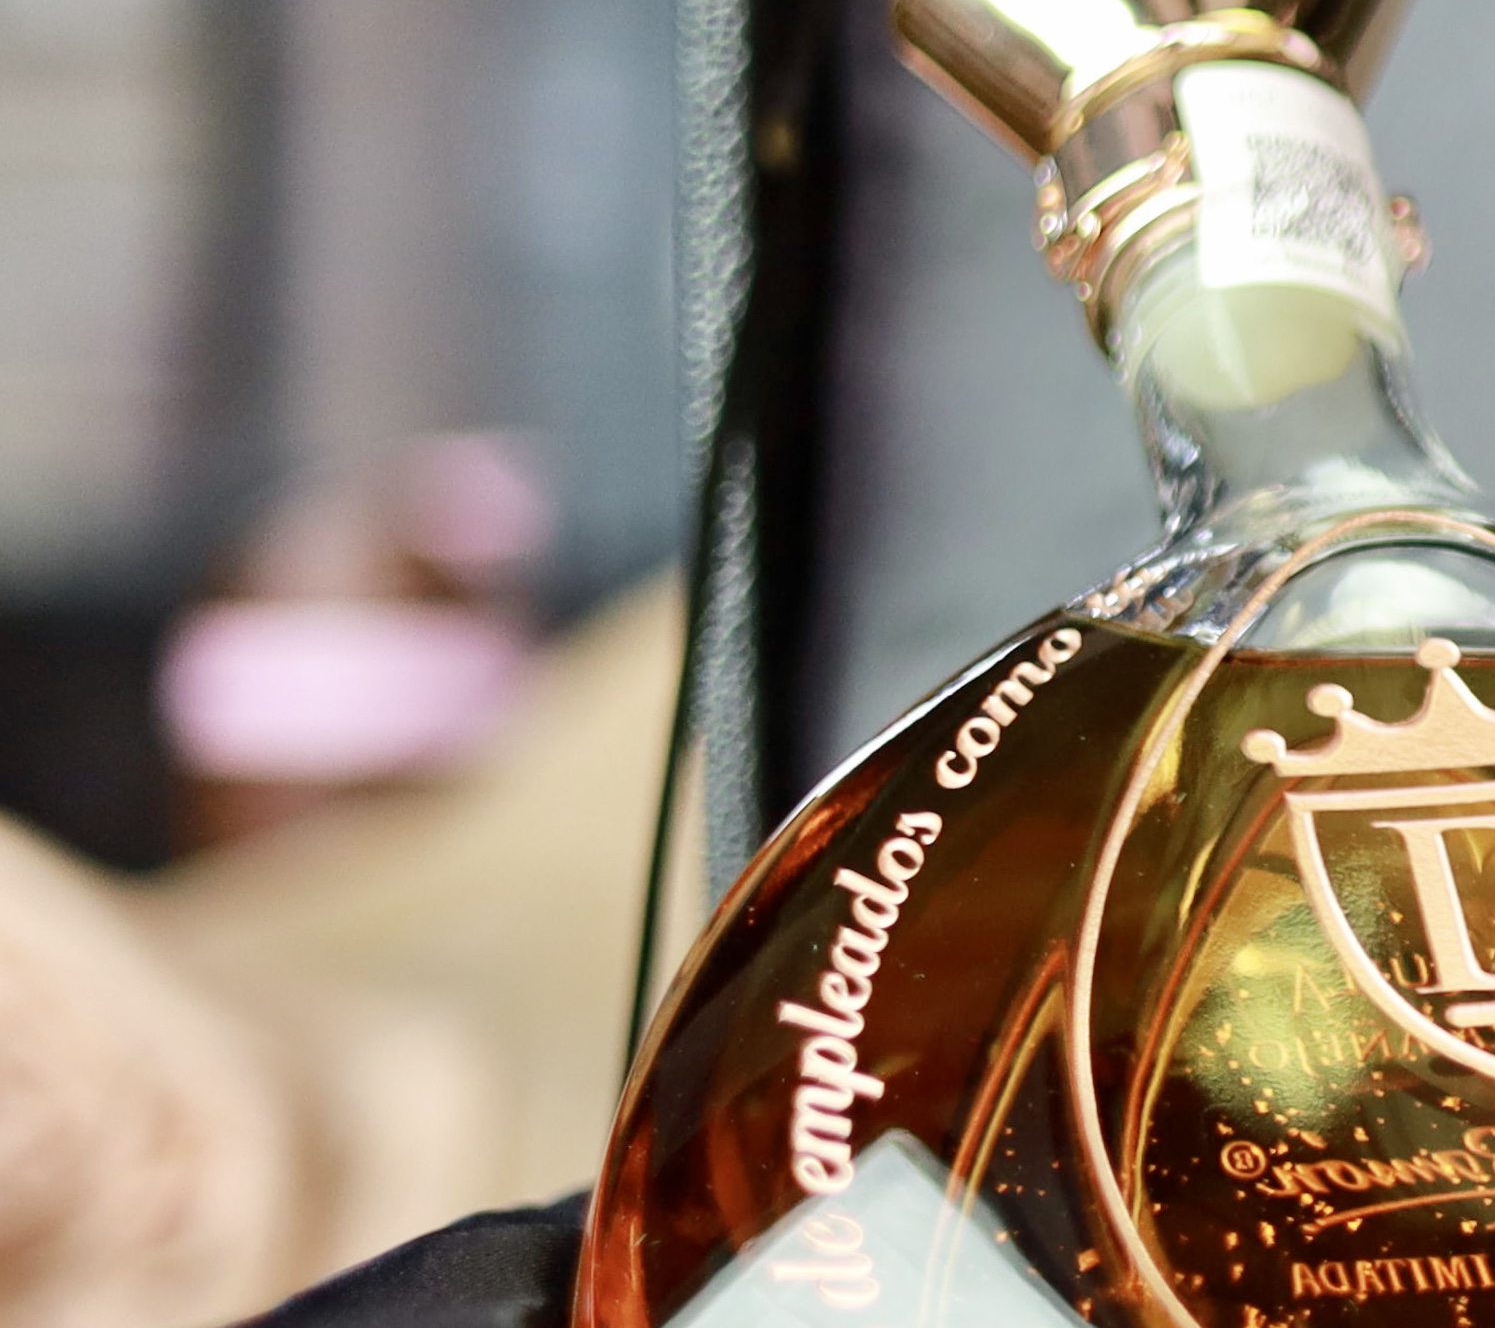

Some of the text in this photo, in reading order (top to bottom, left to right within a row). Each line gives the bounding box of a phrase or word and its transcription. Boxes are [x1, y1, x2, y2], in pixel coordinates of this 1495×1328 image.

[936, 626, 1084, 790] como
[777, 809, 943, 1197] empleados
[769, 1211, 881, 1309] de
